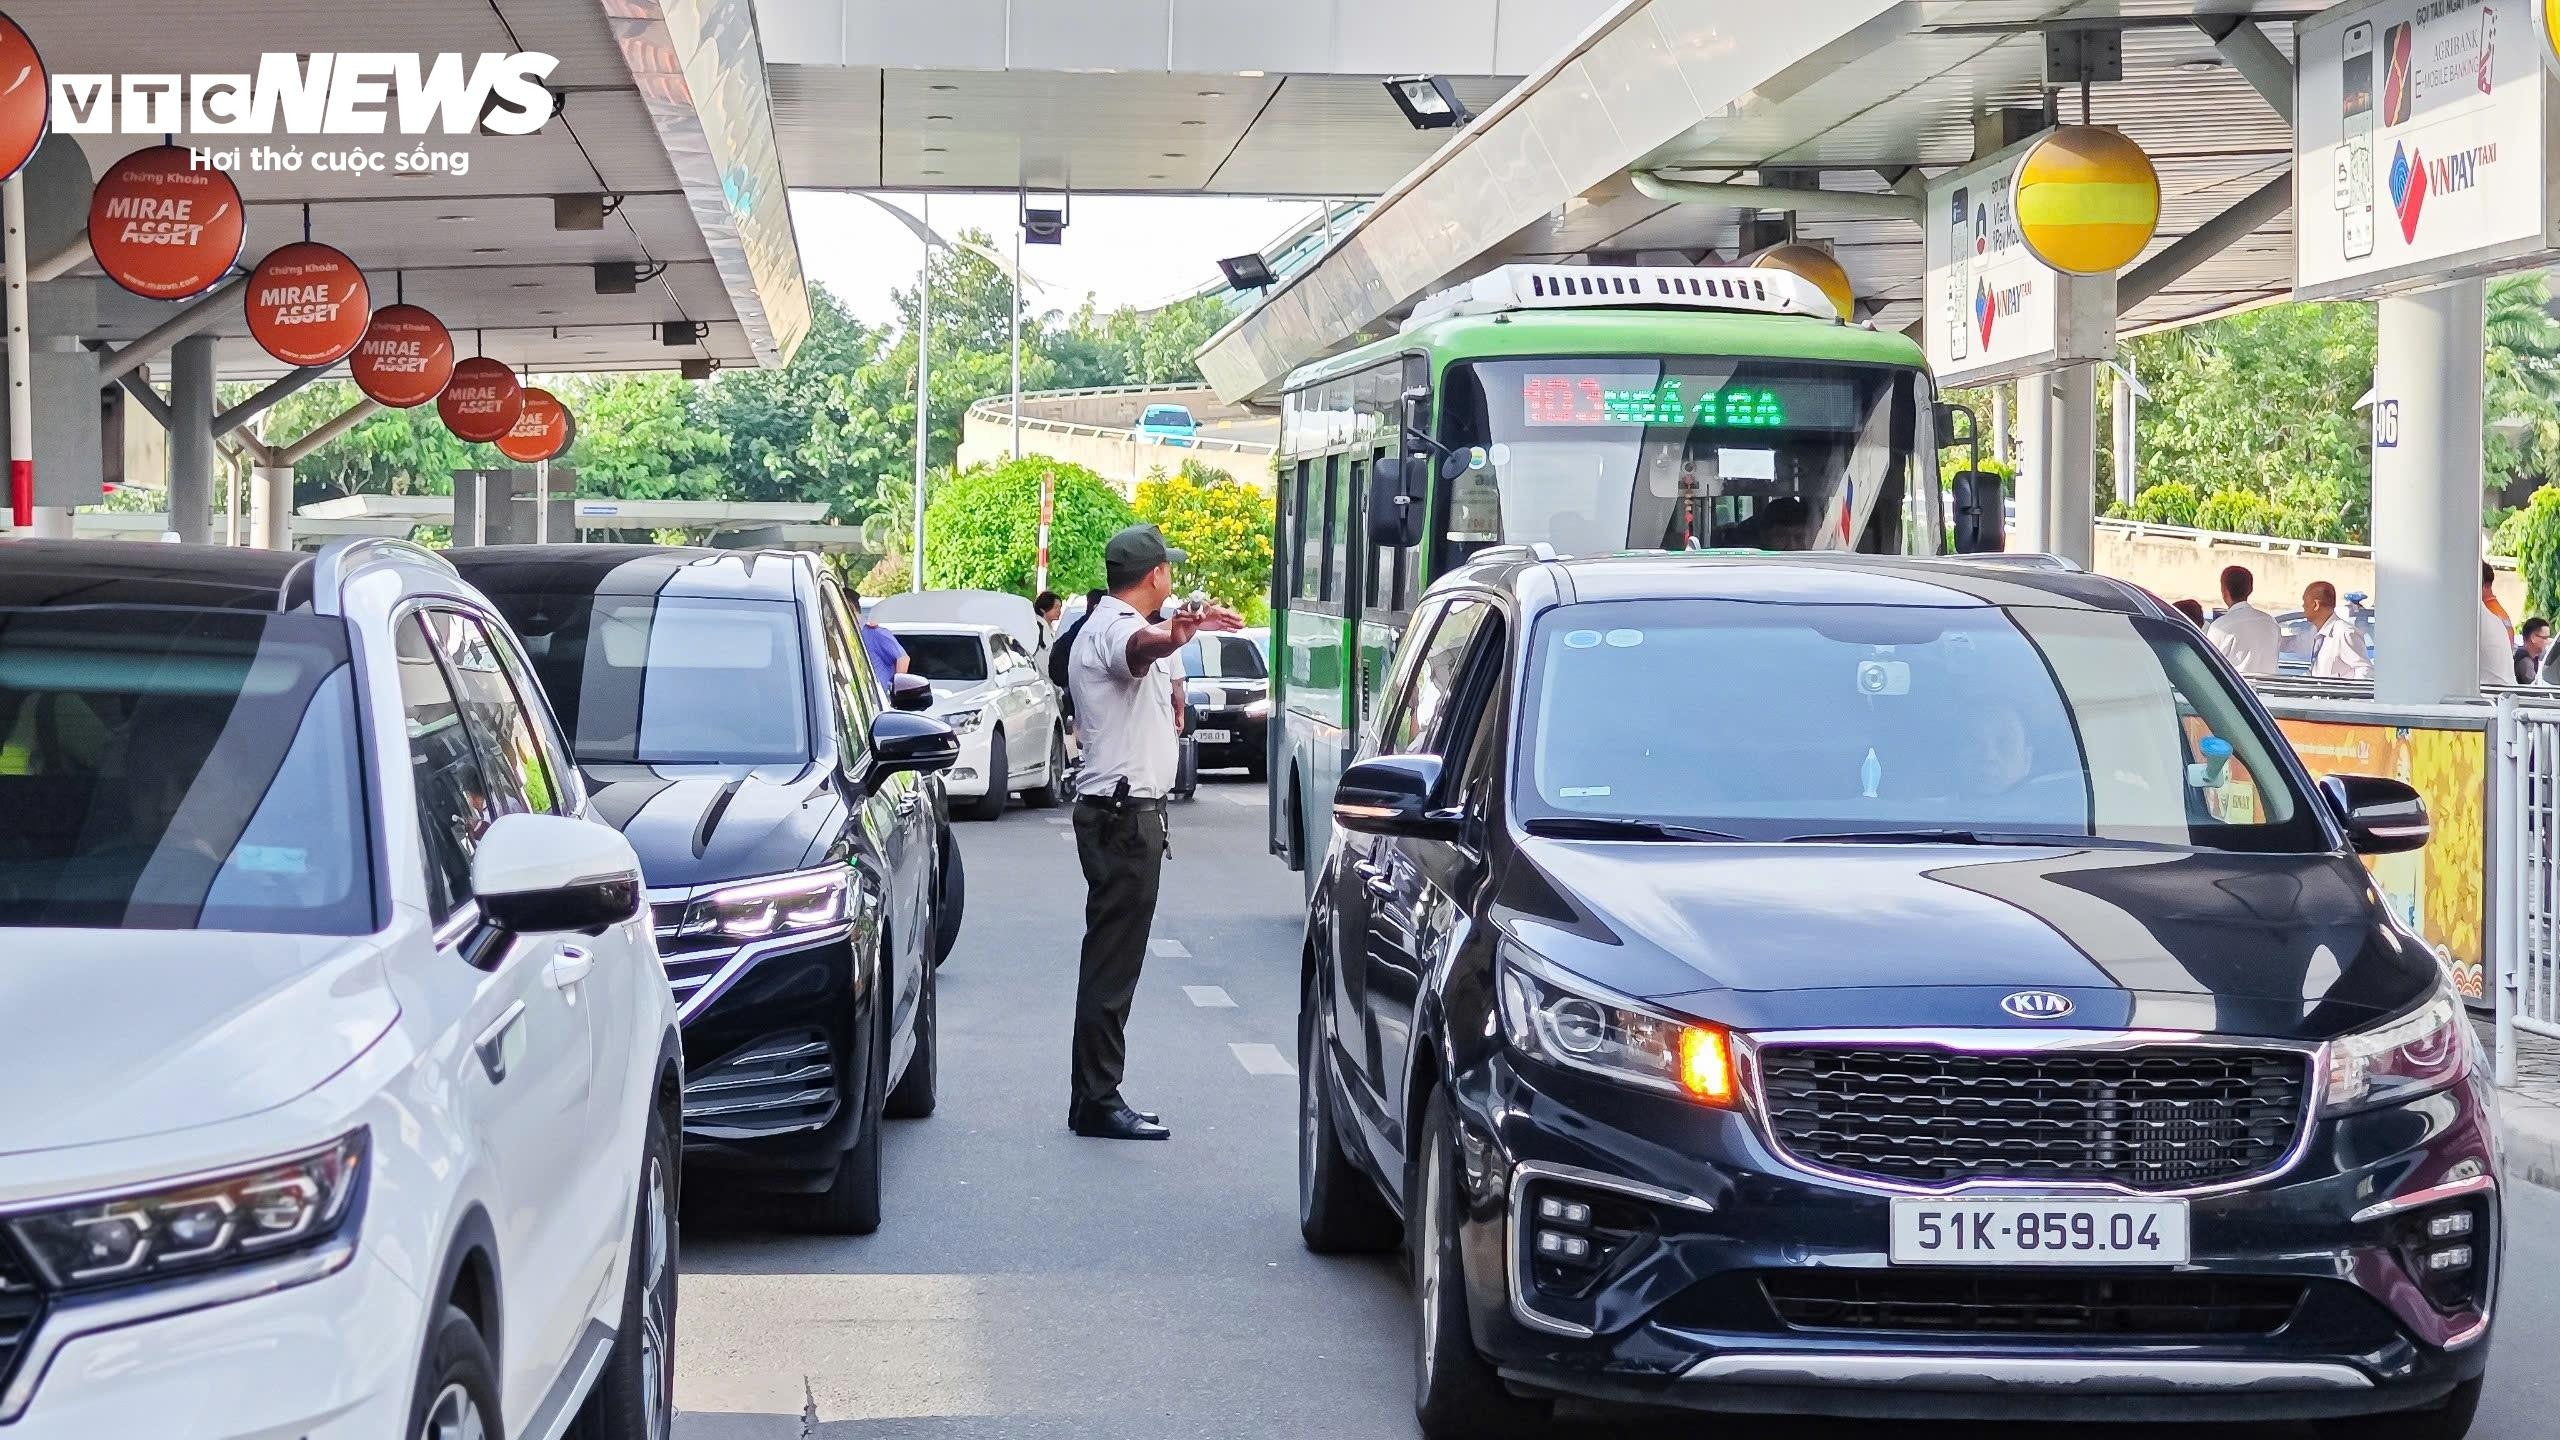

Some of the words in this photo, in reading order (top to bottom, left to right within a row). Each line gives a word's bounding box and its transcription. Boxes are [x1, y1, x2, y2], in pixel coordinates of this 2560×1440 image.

[2433, 28, 2479, 62] AGRIBANK
[167, 172, 208, 186] Khoán
[106, 197, 193, 221] MIRAE
[120, 221, 204, 246] ASSET
[260, 284, 329, 307] MIRAE
[274, 303, 340, 326] ASSET
[362, 340, 421, 356] MIRAE
[372, 356, 429, 373] ASSET
[447, 386, 497, 401] MIRAE
[457, 400, 504, 414] ASSET
[520, 412, 544, 425] RAE
[2012, 994, 2067, 1012] KIA
[1917, 1211, 2161, 1251] 51K-859.04
